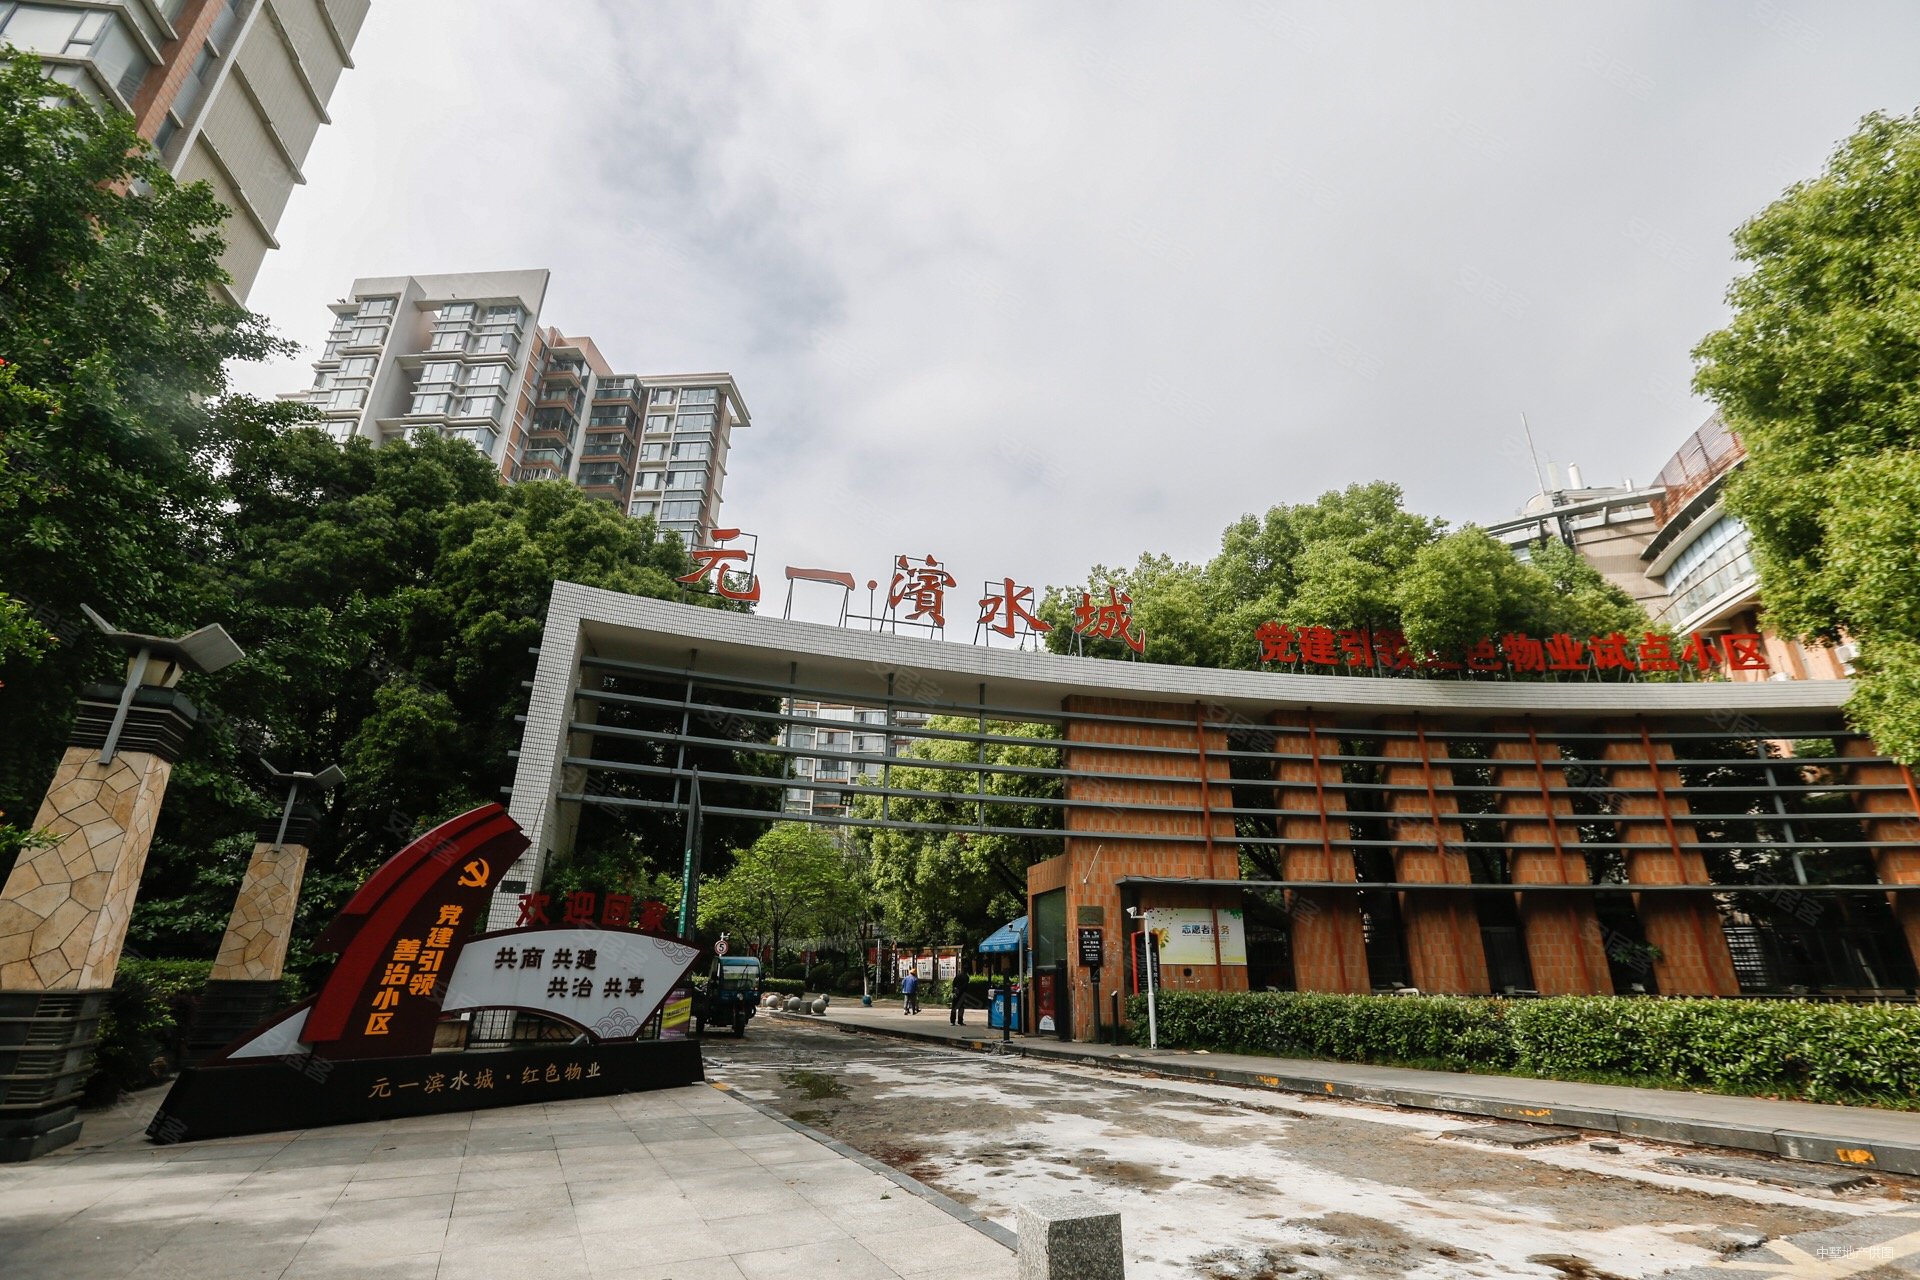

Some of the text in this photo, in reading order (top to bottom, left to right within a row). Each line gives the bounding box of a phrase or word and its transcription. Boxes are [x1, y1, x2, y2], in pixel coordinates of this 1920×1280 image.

[516, 890, 668, 932] 欢迎回家
[408, 905, 463, 995] 党建引领
[495, 947, 597, 970] 共商 共建
[719, 943, 725, 952] 5
[364, 938, 421, 1035] 善治小区
[547, 976, 645, 998] 共治 共享
